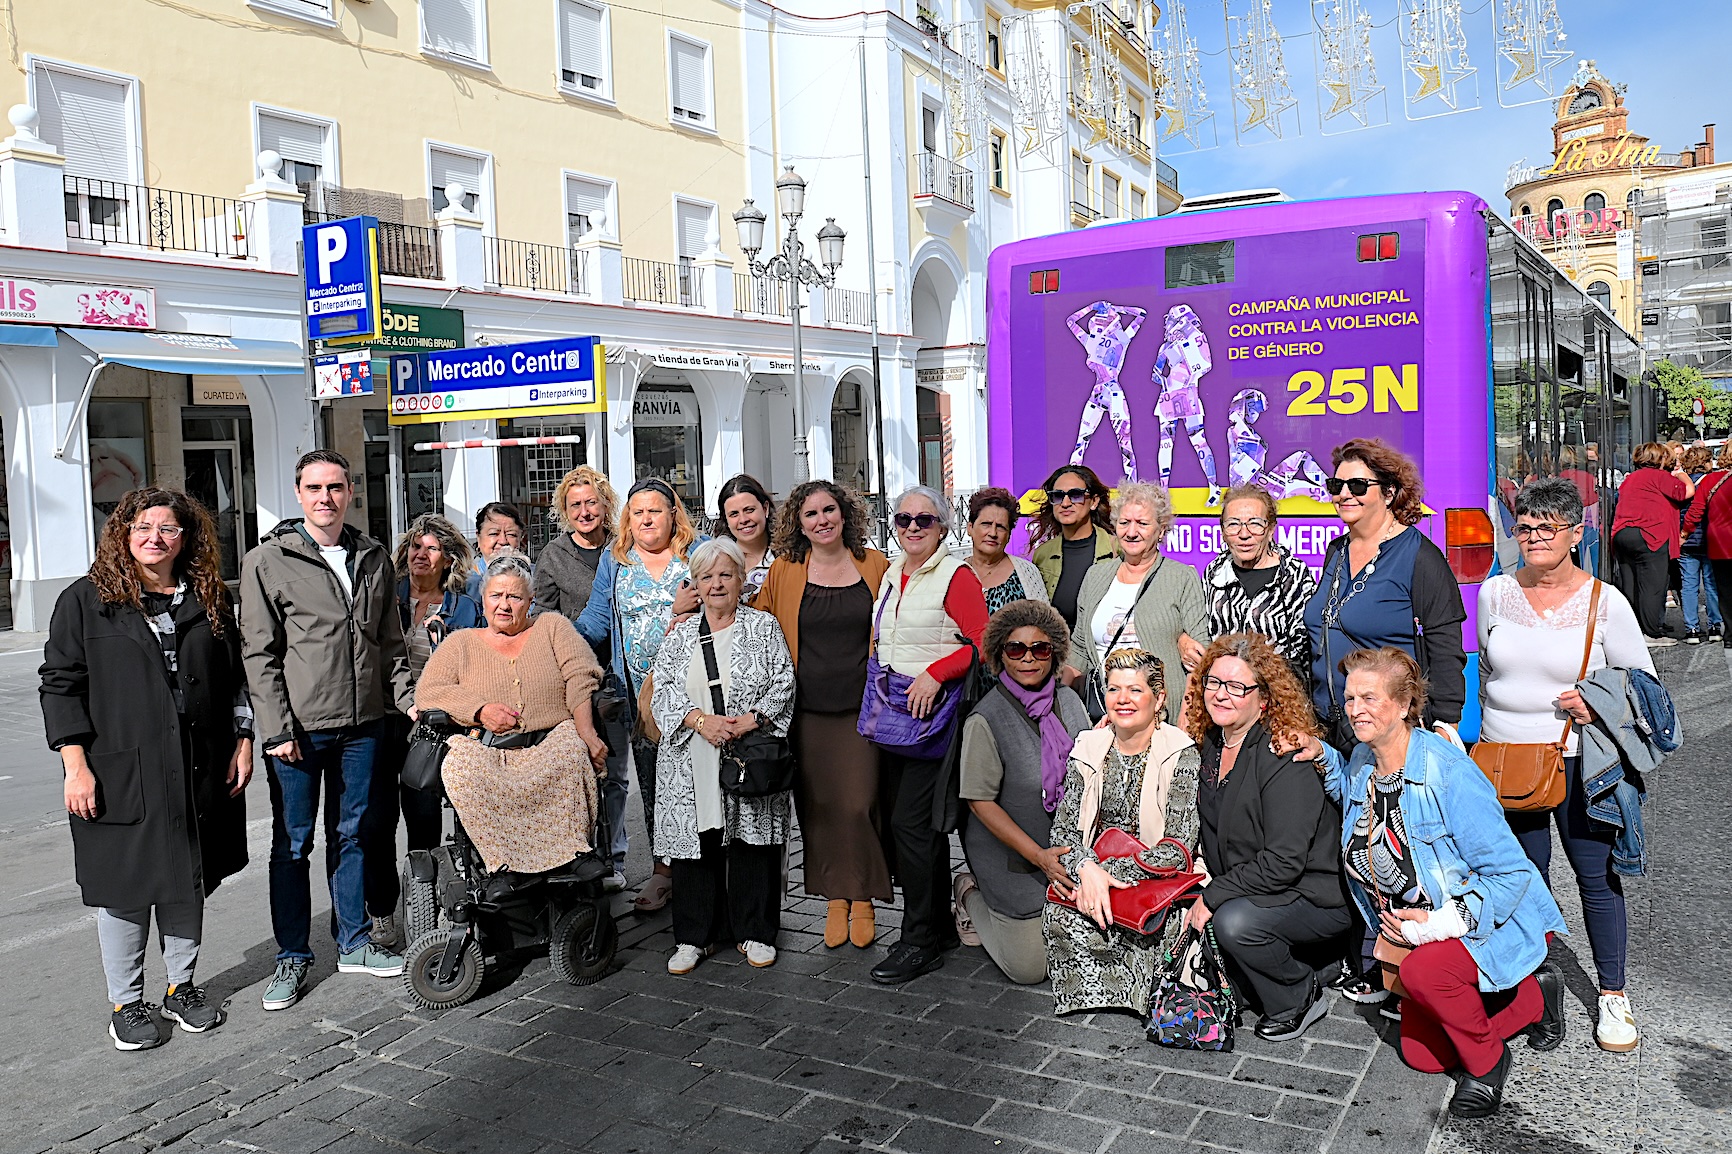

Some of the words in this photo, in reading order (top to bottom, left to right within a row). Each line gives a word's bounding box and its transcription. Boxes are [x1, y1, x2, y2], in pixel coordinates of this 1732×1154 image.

[1539, 137, 1587, 177] La
[316, 225, 348, 284] P
[309, 285, 338, 298] Mercado
[1228, 296, 1311, 317] CAMPAÑA
[1315, 289, 1411, 309] MUNICIPAL
[320, 298, 362, 311] Interparking
[1228, 320, 1298, 338] CONTRA
[1301, 319, 1323, 333] LA
[1325, 311, 1420, 331] VIOLENCIA
[392, 336, 399, 346] &
[399, 336, 433, 348] CLOTHING
[433, 338, 457, 348] BRAND
[1228, 346, 1250, 360] DE
[1253, 341, 1325, 359] GÉNERO
[658, 355, 689, 365] tienda
[690, 356, 701, 365] de
[703, 357, 725, 366] Gran
[396, 358, 413, 391] P
[427, 354, 505, 382] Mercado
[203, 391, 235, 400] CURATED
[538, 387, 587, 400] Interparking
[1286, 363, 1419, 417] 25N
[1166, 524, 1192, 553] NO
